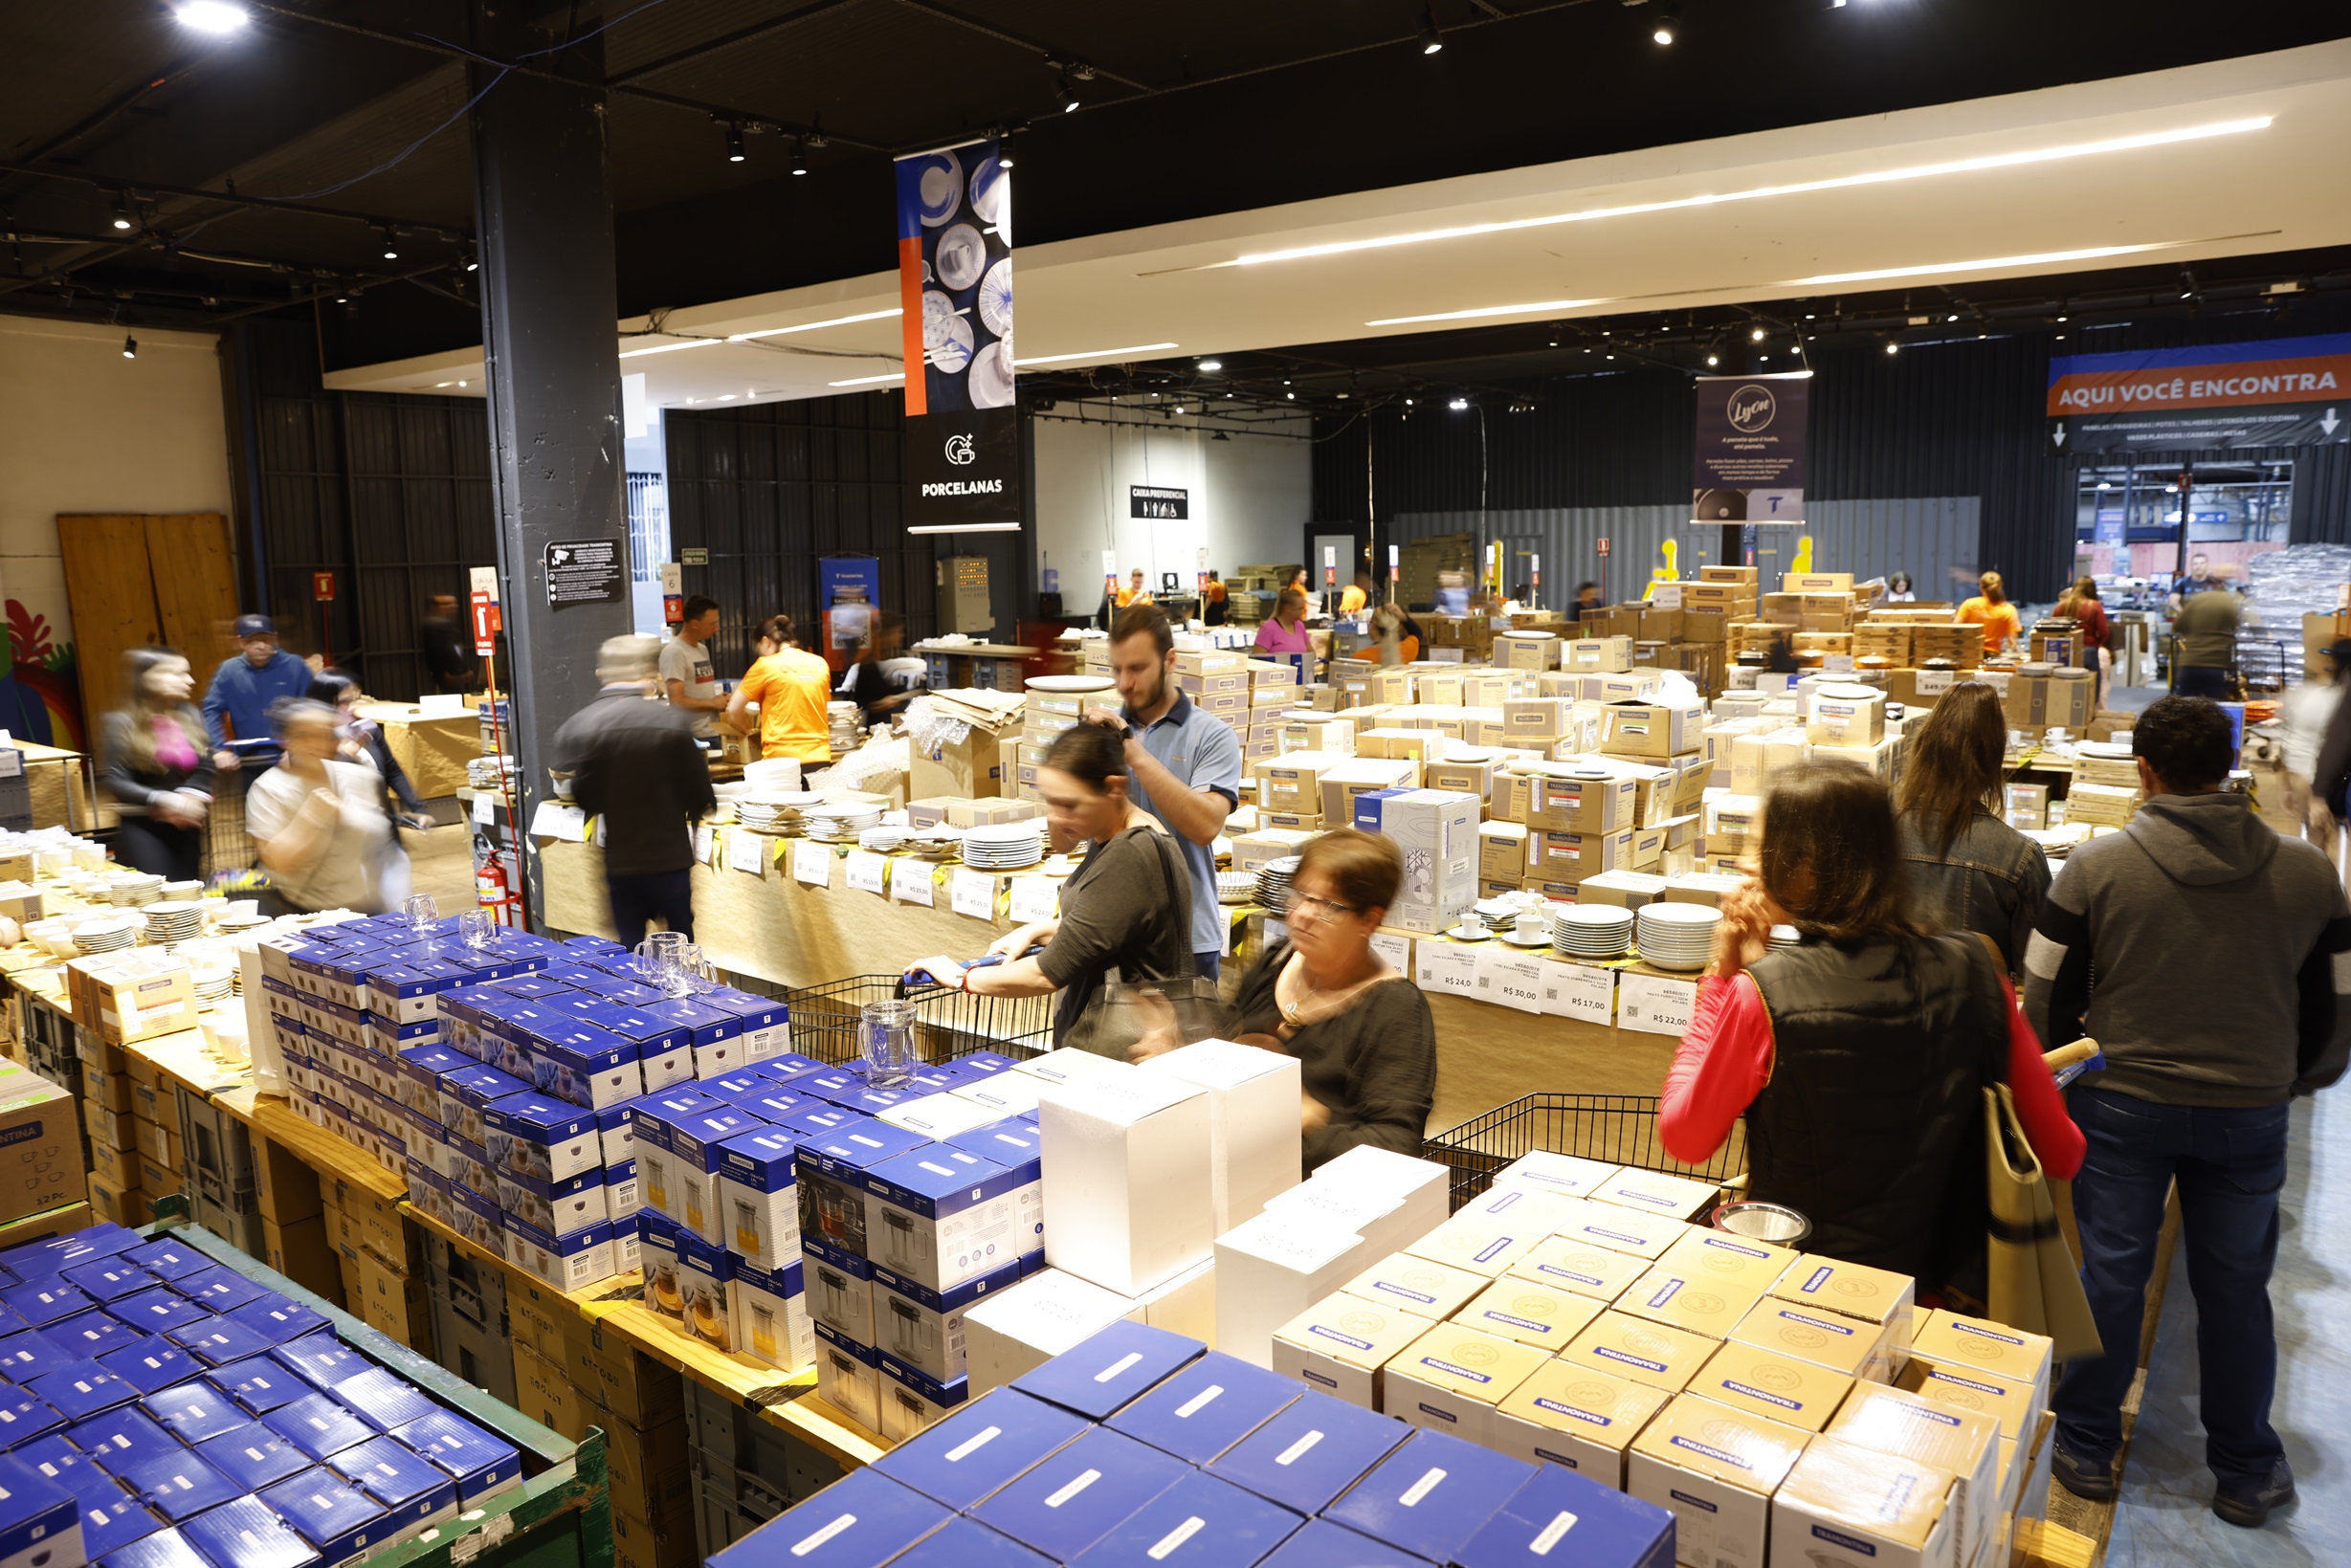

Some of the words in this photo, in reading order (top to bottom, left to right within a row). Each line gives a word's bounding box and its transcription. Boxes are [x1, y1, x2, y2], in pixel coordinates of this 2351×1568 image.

[2058, 386, 2115, 408] AQUI
[2118, 378, 2185, 402] VOCÊ
[2188, 371, 2339, 398] ENCONTRA
[1733, 398, 1770, 423] Lyon
[921, 479, 1003, 497] PORCELANAS
[1132, 488, 1150, 497] CAIXA
[1150, 489, 1187, 499] PREFERENCIAL
[669, 580, 676, 588] 6
[1549, 783, 1580, 791] TRAMONTINA
[1549, 834, 1580, 844] TRAMONTINA
[1544, 885, 1577, 894] TRAMONTINA
[1445, 977, 1454, 985] R$
[1455, 978, 1472, 987] 24,0
[1503, 986, 1514, 995] R$
[1515, 989, 1537, 1000] 30,00
[1584, 1001, 1606, 1010] 17,00
[1653, 1014, 1663, 1023] R$
[1665, 1016, 1687, 1027] 22,00
[730, 1155, 753, 1169] TRAMONTINA
[36, 1195, 50, 1205] 12
[650, 1235, 675, 1247] TRAMONTINA
[1588, 1226, 1642, 1245] TRAMONTINA
[1478, 1238, 1509, 1261] TRAMONTINA
[1709, 1239, 1765, 1258] TRAMONTINA
[689, 1257, 712, 1270] TRAMONTINA
[746, 1260, 771, 1274] TRAMONTINA
[1543, 1265, 1599, 1285] TRAMONTINA
[1805, 1268, 1831, 1292] TRAMONTINA
[1378, 1282, 1431, 1303] TRAMONTINA
[1652, 1280, 1683, 1307] TRAMONTINA
[1489, 1311, 1545, 1332] TRAMONTINA
[1785, 1312, 1847, 1334] TRAMONTINA
[1314, 1325, 1368, 1350] TRAMONTINA
[1957, 1323, 2018, 1344] TRAMONTINA
[1600, 1347, 1661, 1371] TRAMONTINA
[1304, 1371, 1336, 1386] TRAMONTINA
[1426, 1358, 1486, 1382] TRAMONTINA
[1934, 1371, 1999, 1394] TRAMONTINA
[1728, 1381, 1795, 1408] TRAMONTINA
[1421, 1403, 1454, 1422] TRAMONTINA
[1541, 1398, 1605, 1424] TRAMONTINA
[1537, 1448, 1575, 1467] TRAMONTINA
[1674, 1491, 1715, 1512] TRAMONTINA
[1817, 1529, 1873, 1555] TRAMONTINA
